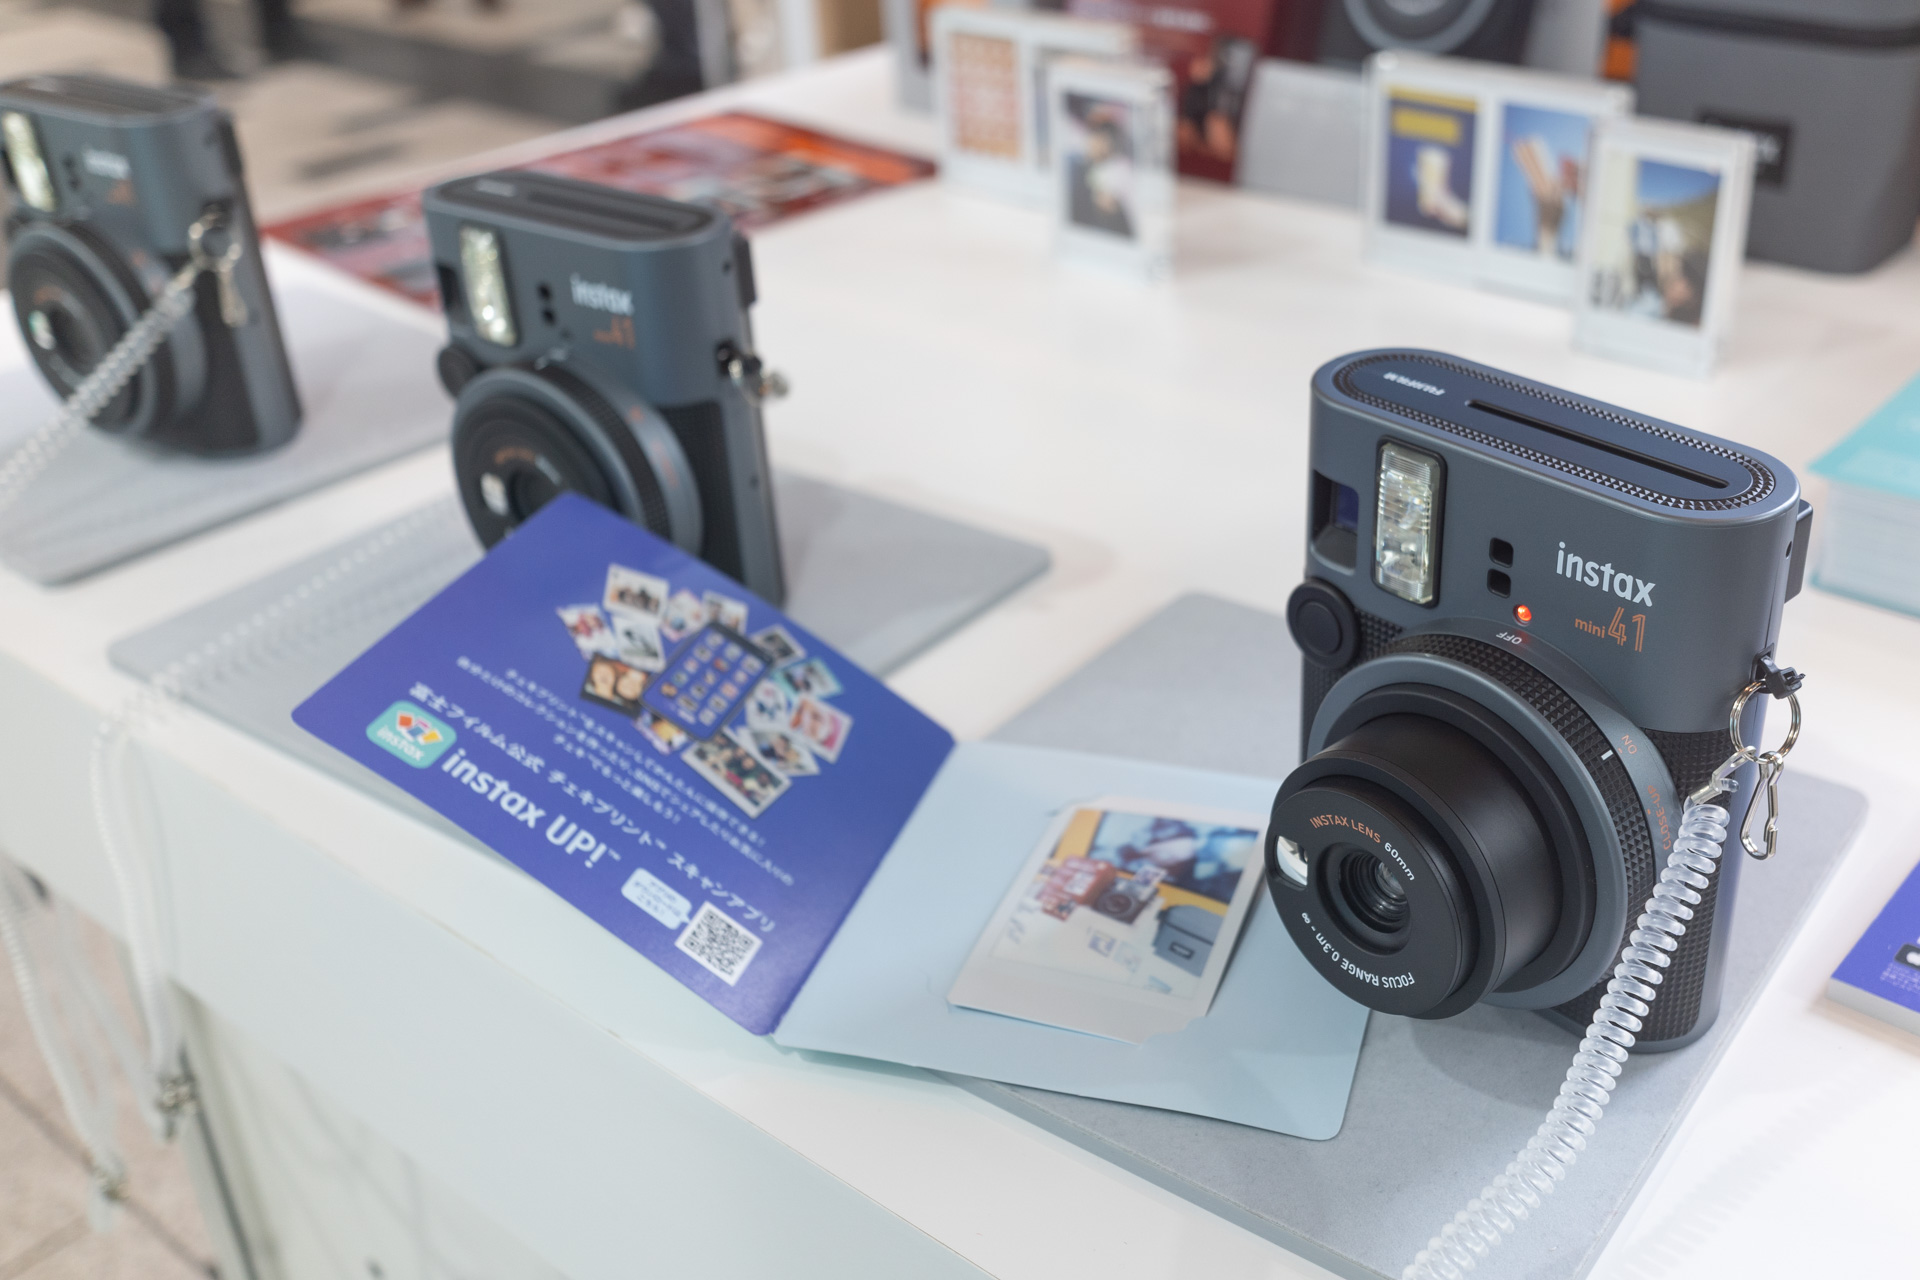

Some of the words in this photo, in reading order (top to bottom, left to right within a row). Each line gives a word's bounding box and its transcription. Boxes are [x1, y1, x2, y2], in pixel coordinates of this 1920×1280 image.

[1556, 541, 1656, 607] instax
[1495, 631, 1523, 645] OFF
[1574, 618, 1606, 639] mini
[1607, 606, 1646, 652] 41
[376, 724, 424, 762] instax
[1621, 734, 1638, 754] ON
[441, 748, 546, 829] instax
[1647, 784, 1672, 850] CLOSE-UP
[1309, 814, 1350, 829] INSTAX
[1351, 819, 1382, 844] LENS
[1384, 842, 1415, 881] 60mm
[666, 851, 776, 932] スキャンアプリ
[1315, 932, 1341, 962] 0.3m
[1340, 958, 1380, 987] RANGE
[1381, 971, 1416, 989] FOCUS
